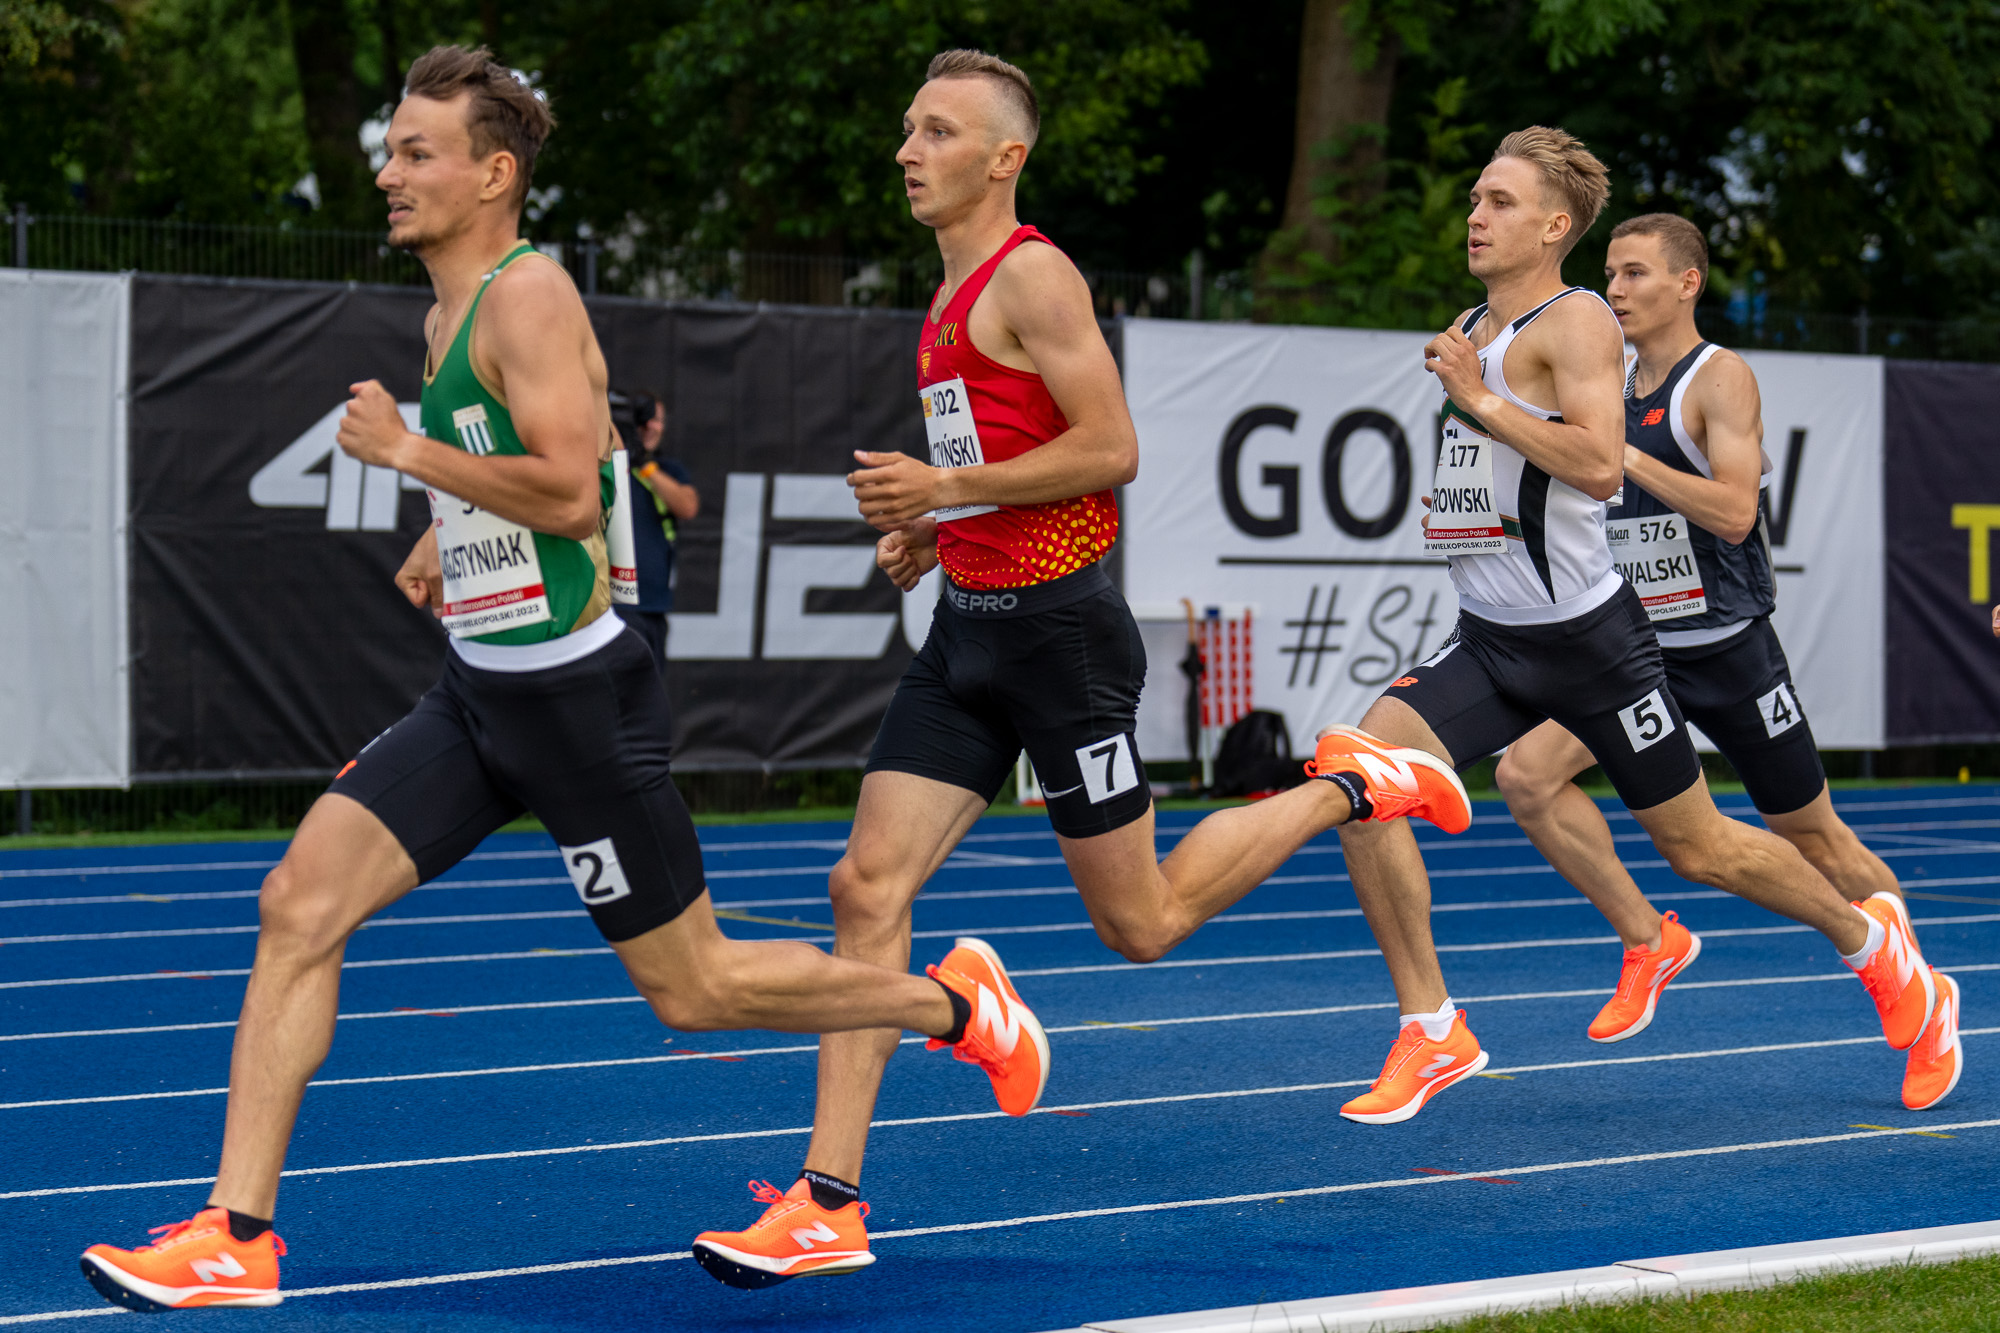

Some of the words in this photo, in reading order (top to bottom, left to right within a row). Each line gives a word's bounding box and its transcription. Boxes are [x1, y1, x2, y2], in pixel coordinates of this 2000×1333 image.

[933, 388, 960, 417] 502
[1450, 445, 1480, 467] 177
[1432, 530, 1469, 538] Mistrzostwa
[1469, 528, 1490, 538] Polski
[1640, 520, 1677, 543] 576
[1431, 541, 1483, 550] WIELKOPOLSKI
[1483, 540, 1502, 548] 2023
[498, 589, 524, 604] Polski
[969, 593, 1018, 612] PRO
[1668, 592, 1689, 602] Polski
[1681, 601, 1701, 611] 2023
[515, 603, 540, 618] 2023
[1772, 690, 1792, 725] 4
[1633, 699, 1663, 741] 5
[1089, 741, 1118, 793] 7
[572, 851, 615, 900] 2
